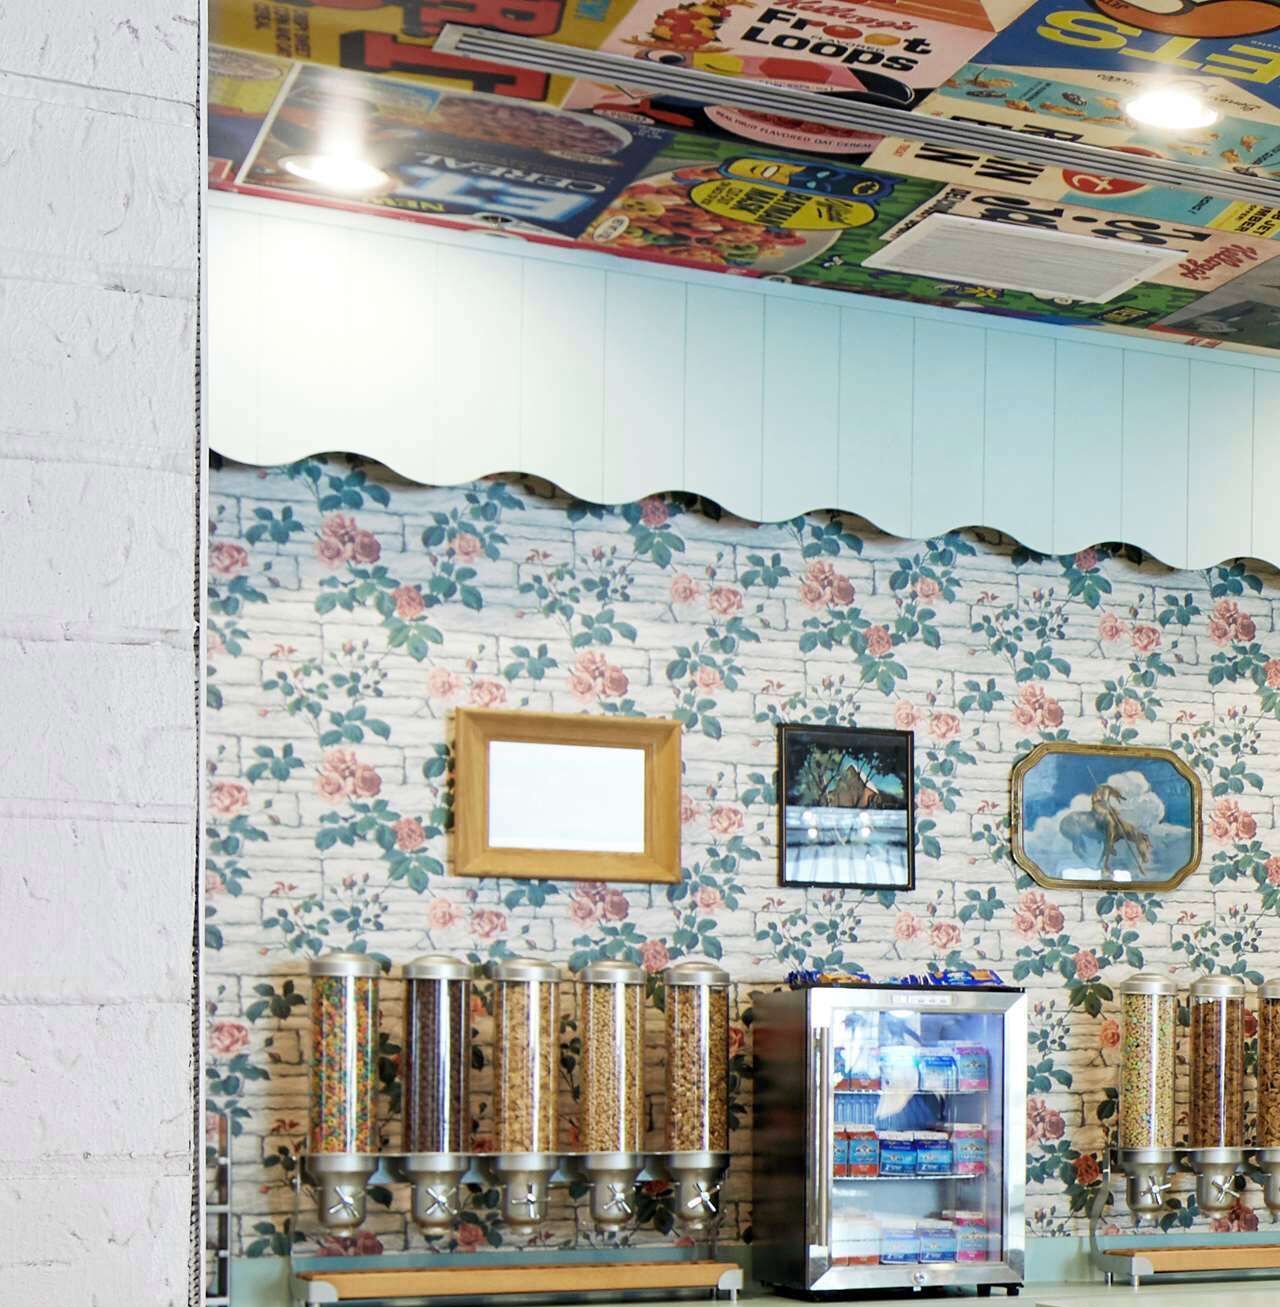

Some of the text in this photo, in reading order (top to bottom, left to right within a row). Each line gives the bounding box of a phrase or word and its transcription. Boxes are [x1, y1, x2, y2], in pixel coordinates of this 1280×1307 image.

[740, 26, 920, 72] Loops
[756, 8, 932, 55] Froot
[416, 152, 606, 193] CEREAL
[1253, 220, 1275, 235] JET
[1178, 244, 1259, 281] Kellogg's
